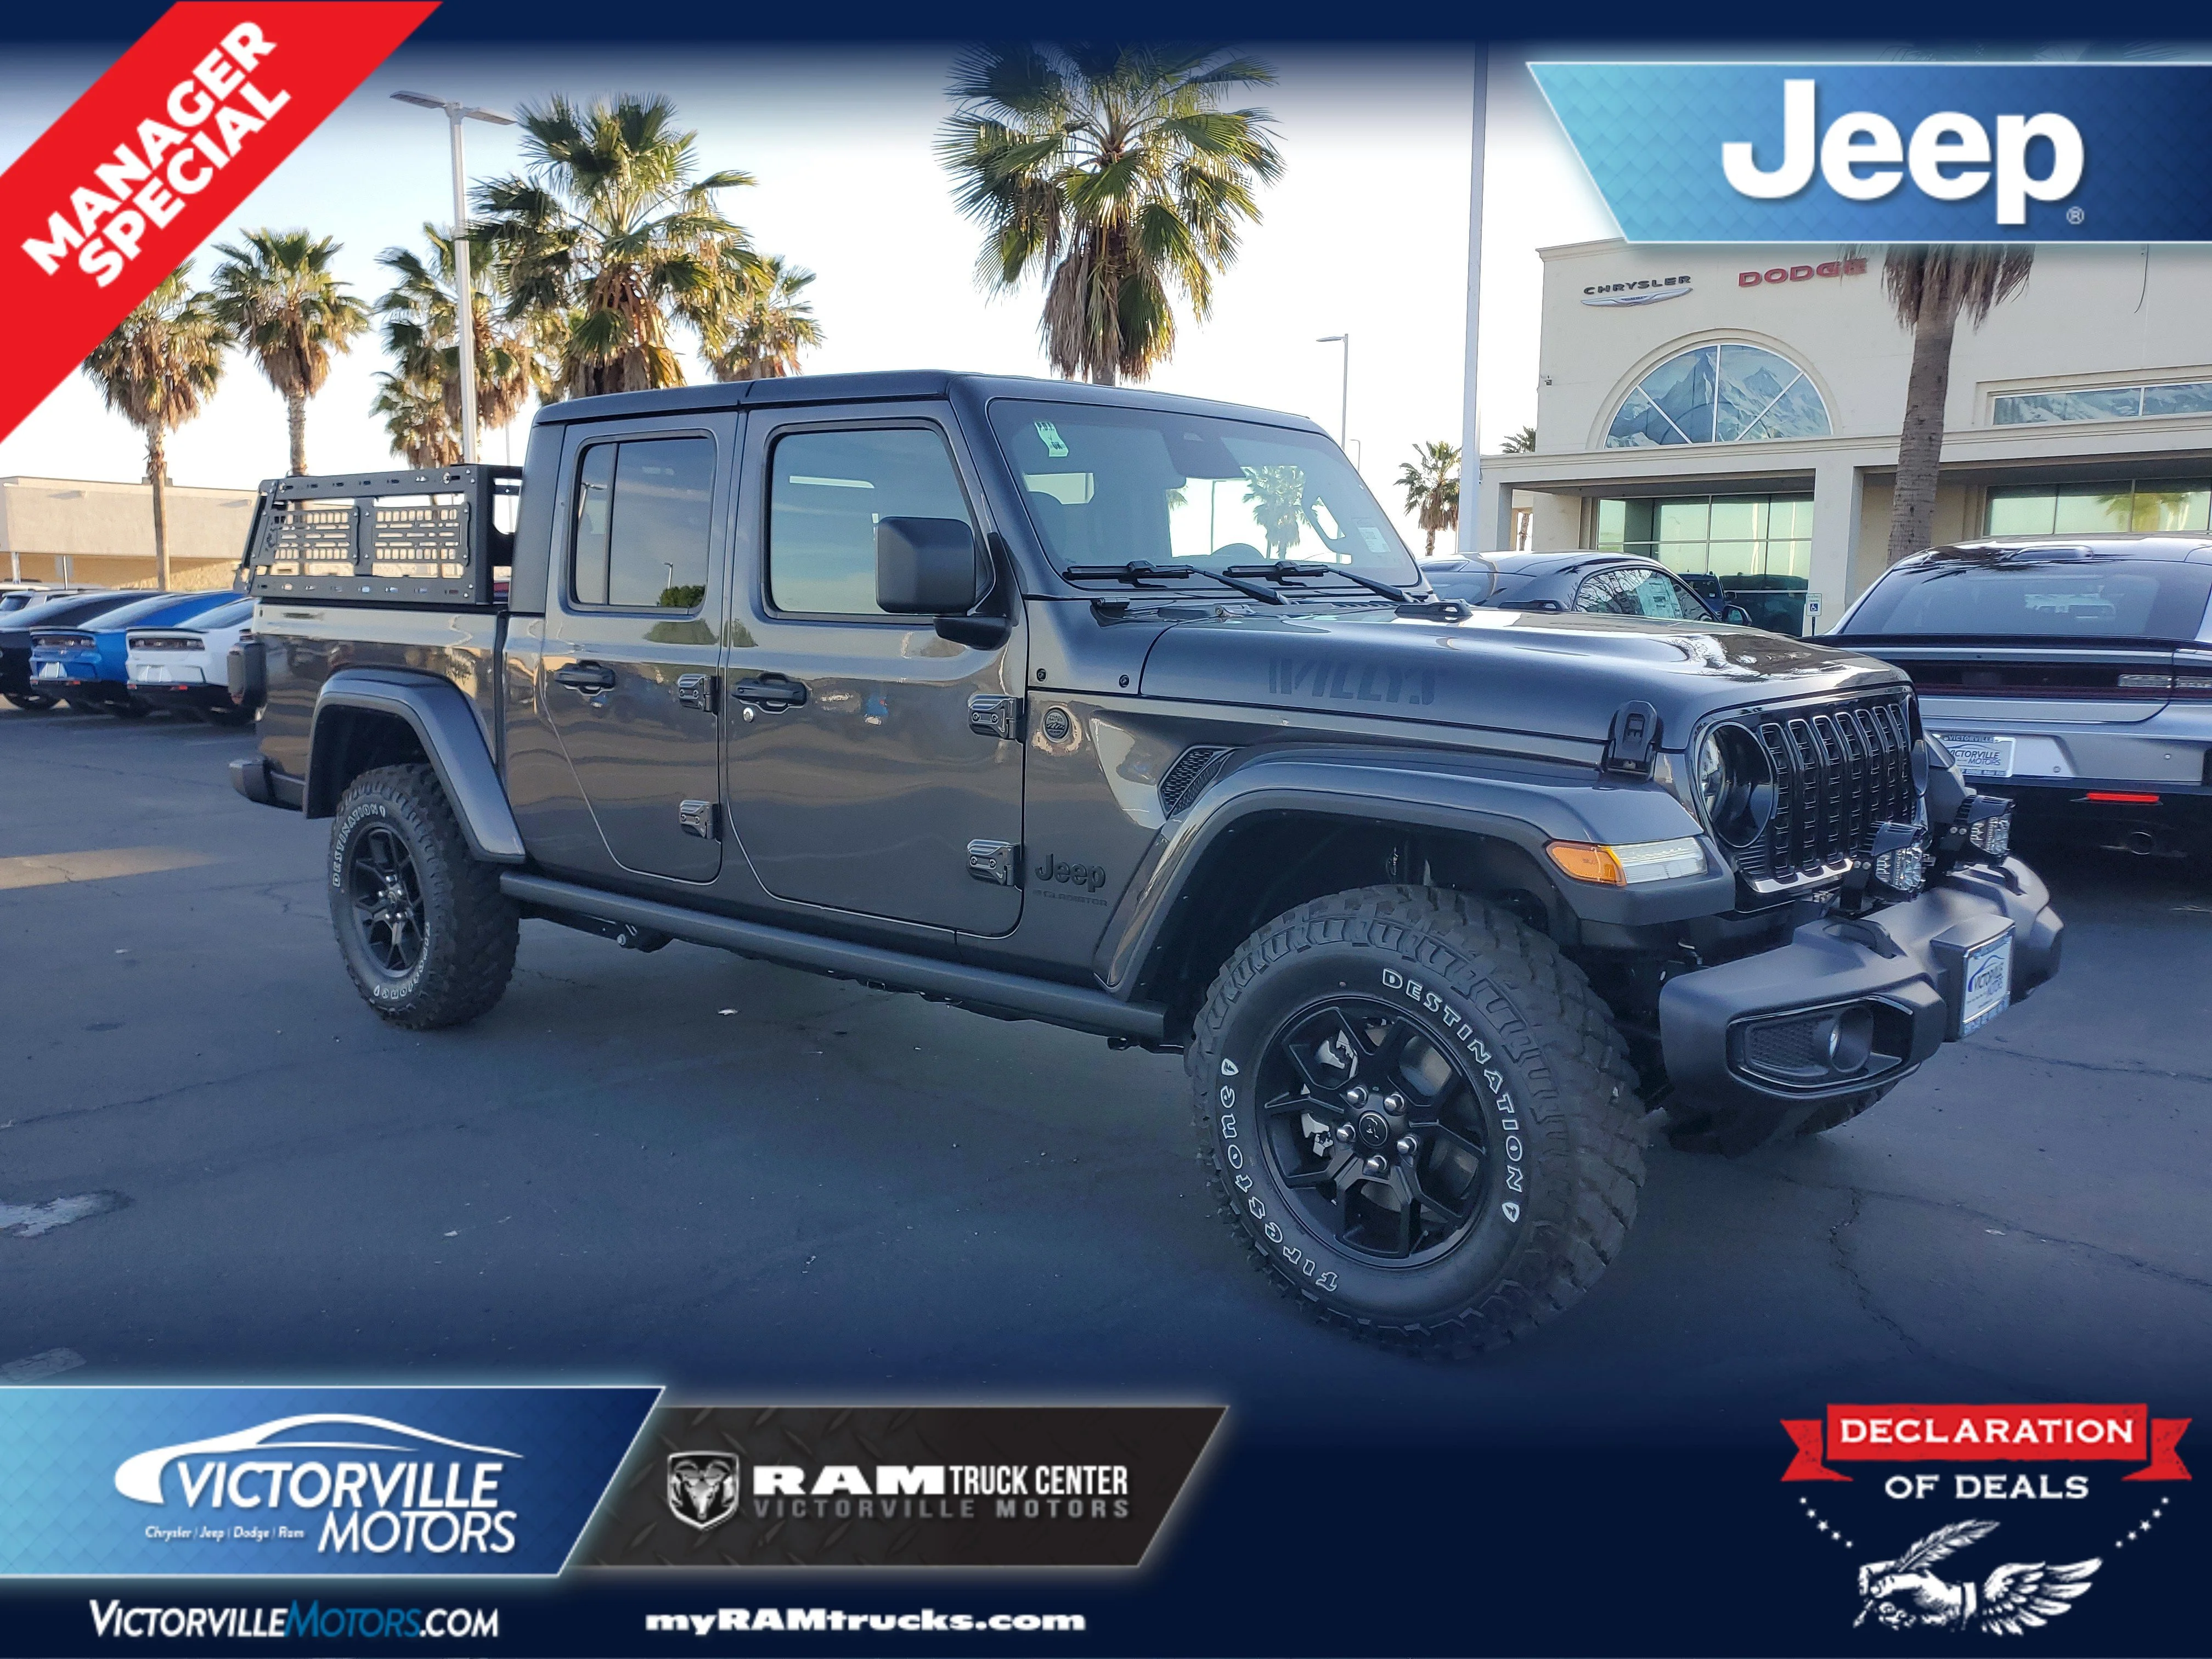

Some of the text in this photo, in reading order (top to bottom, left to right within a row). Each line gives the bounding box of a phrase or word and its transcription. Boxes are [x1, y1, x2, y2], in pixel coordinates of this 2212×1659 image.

[1583, 275, 1691, 295] CHRYSLER
[1738, 258, 1867, 287] DODGE
[332, 803, 379, 888] DESTINATION
[1035, 853, 1106, 893] Jeep
[1382, 968, 1523, 1193] DESTINATION
